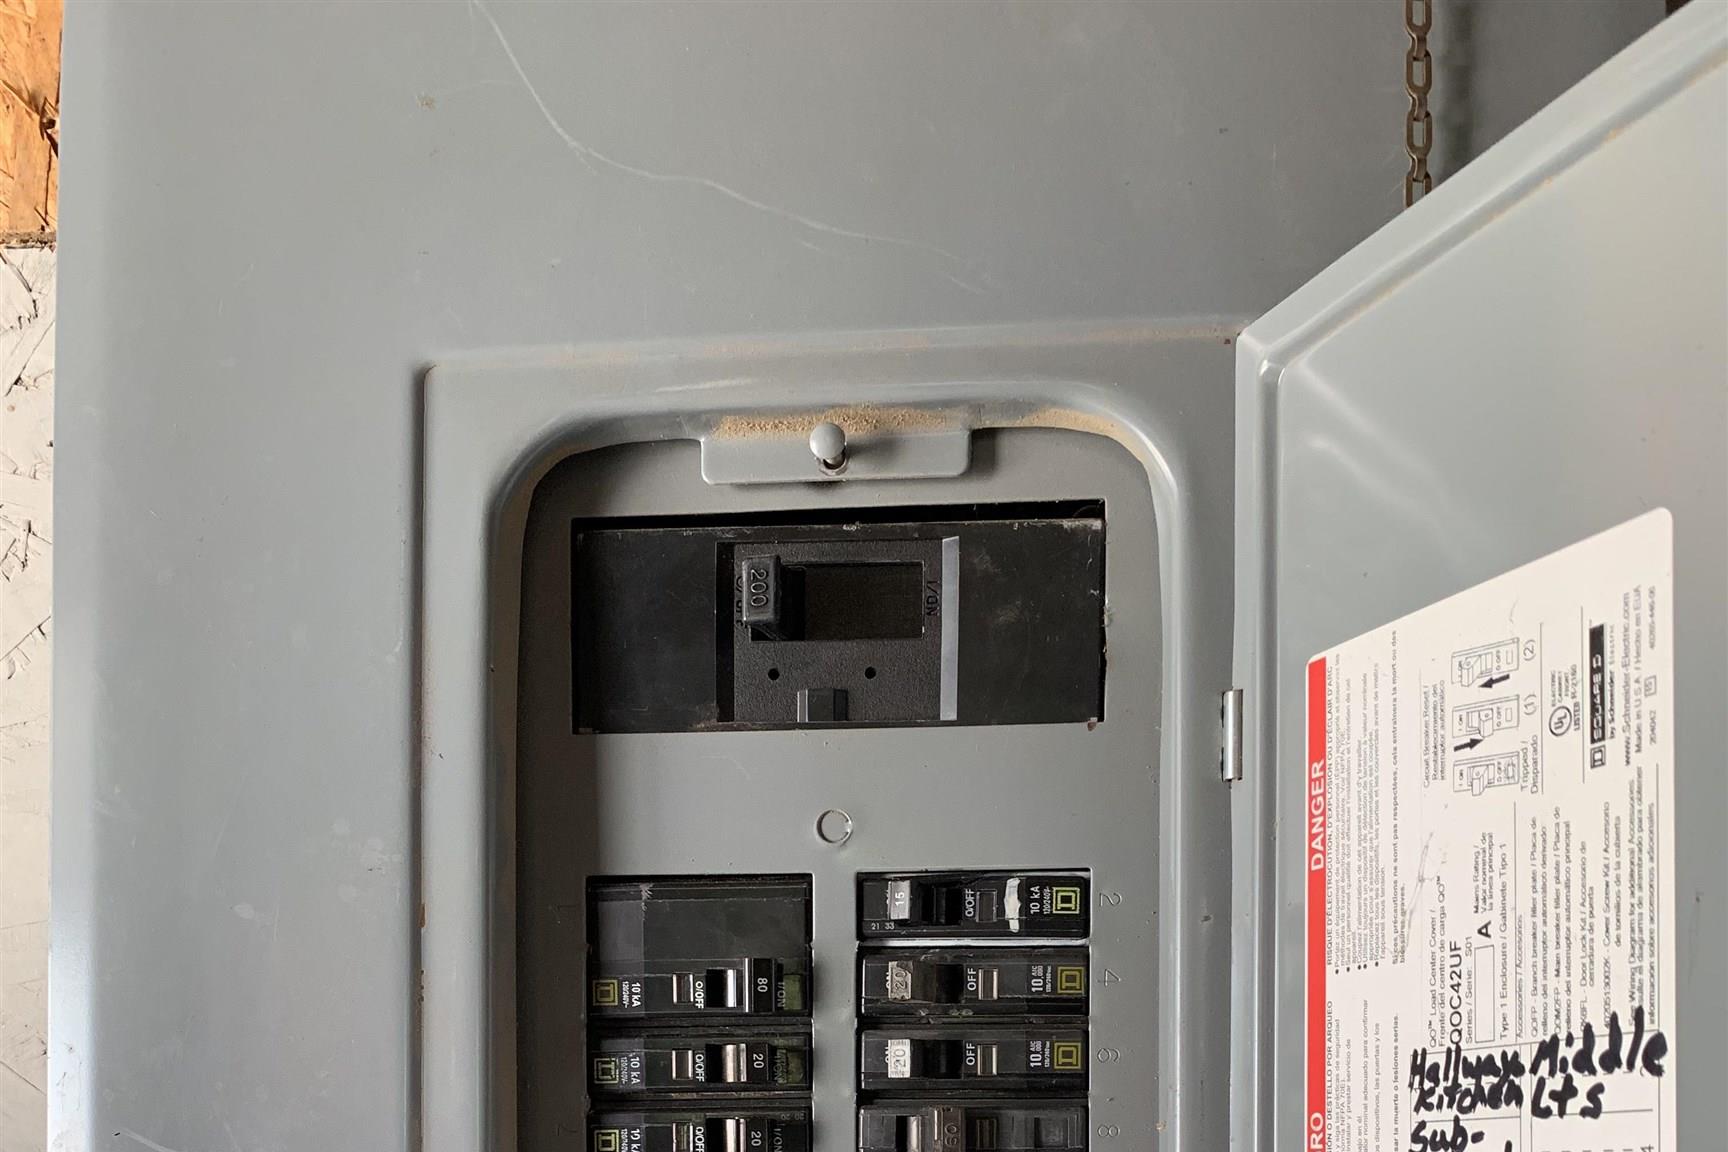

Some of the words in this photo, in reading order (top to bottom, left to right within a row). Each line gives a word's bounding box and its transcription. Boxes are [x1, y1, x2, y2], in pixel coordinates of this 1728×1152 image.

[750, 568, 768, 606] 200
[925, 580, 938, 616] I/ON
[1523, 640, 1536, 661] (2)
[1593, 654, 1601, 668] D
[1523, 694, 1536, 716] (1)
[1593, 672, 1602, 740] SQUARE
[1520, 752, 1529, 790] Tripped
[1312, 760, 1324, 871] DANGER
[1500, 853, 1508, 877] Tipo
[894, 892, 905, 906] 15
[966, 889, 974, 916] O/OFF
[1031, 886, 1040, 900] kA
[1099, 891, 1121, 908] 2
[1031, 902, 1041, 914] 10
[1500, 881, 1508, 933] Gabinete
[872, 922, 880, 930] 21
[885, 922, 895, 930] 33
[1478, 921, 1491, 938] A
[894, 970, 907, 990] 20
[966, 968, 976, 990] OFF
[1098, 968, 1121, 986] 4
[1500, 943, 1508, 999] Enclosure
[632, 982, 641, 994] 10
[695, 981, 704, 1009] O/OFF
[756, 978, 768, 993] 80
[1450, 941, 1462, 1044] QOC42UF
[632, 996, 641, 1007] kA
[1500, 1012, 1508, 1040] Type
[1530, 1005, 1668, 1077] Middle
[630, 1055, 640, 1069] 10
[752, 1054, 763, 1069] 20
[894, 1048, 906, 1068] 20
[966, 1042, 975, 1065] OFF
[1097, 1048, 1120, 1063] 6
[630, 1071, 640, 1084] kA
[695, 1054, 704, 1082] O/OFF
[1413, 1077, 1524, 1115] Kitchen
[1531, 1074, 1605, 1119] Lts
[630, 1128, 640, 1142] 10
[1097, 1125, 1120, 1138] 8
[1327, 1123, 1334, 1131] O
[750, 1131, 762, 1146] 20
